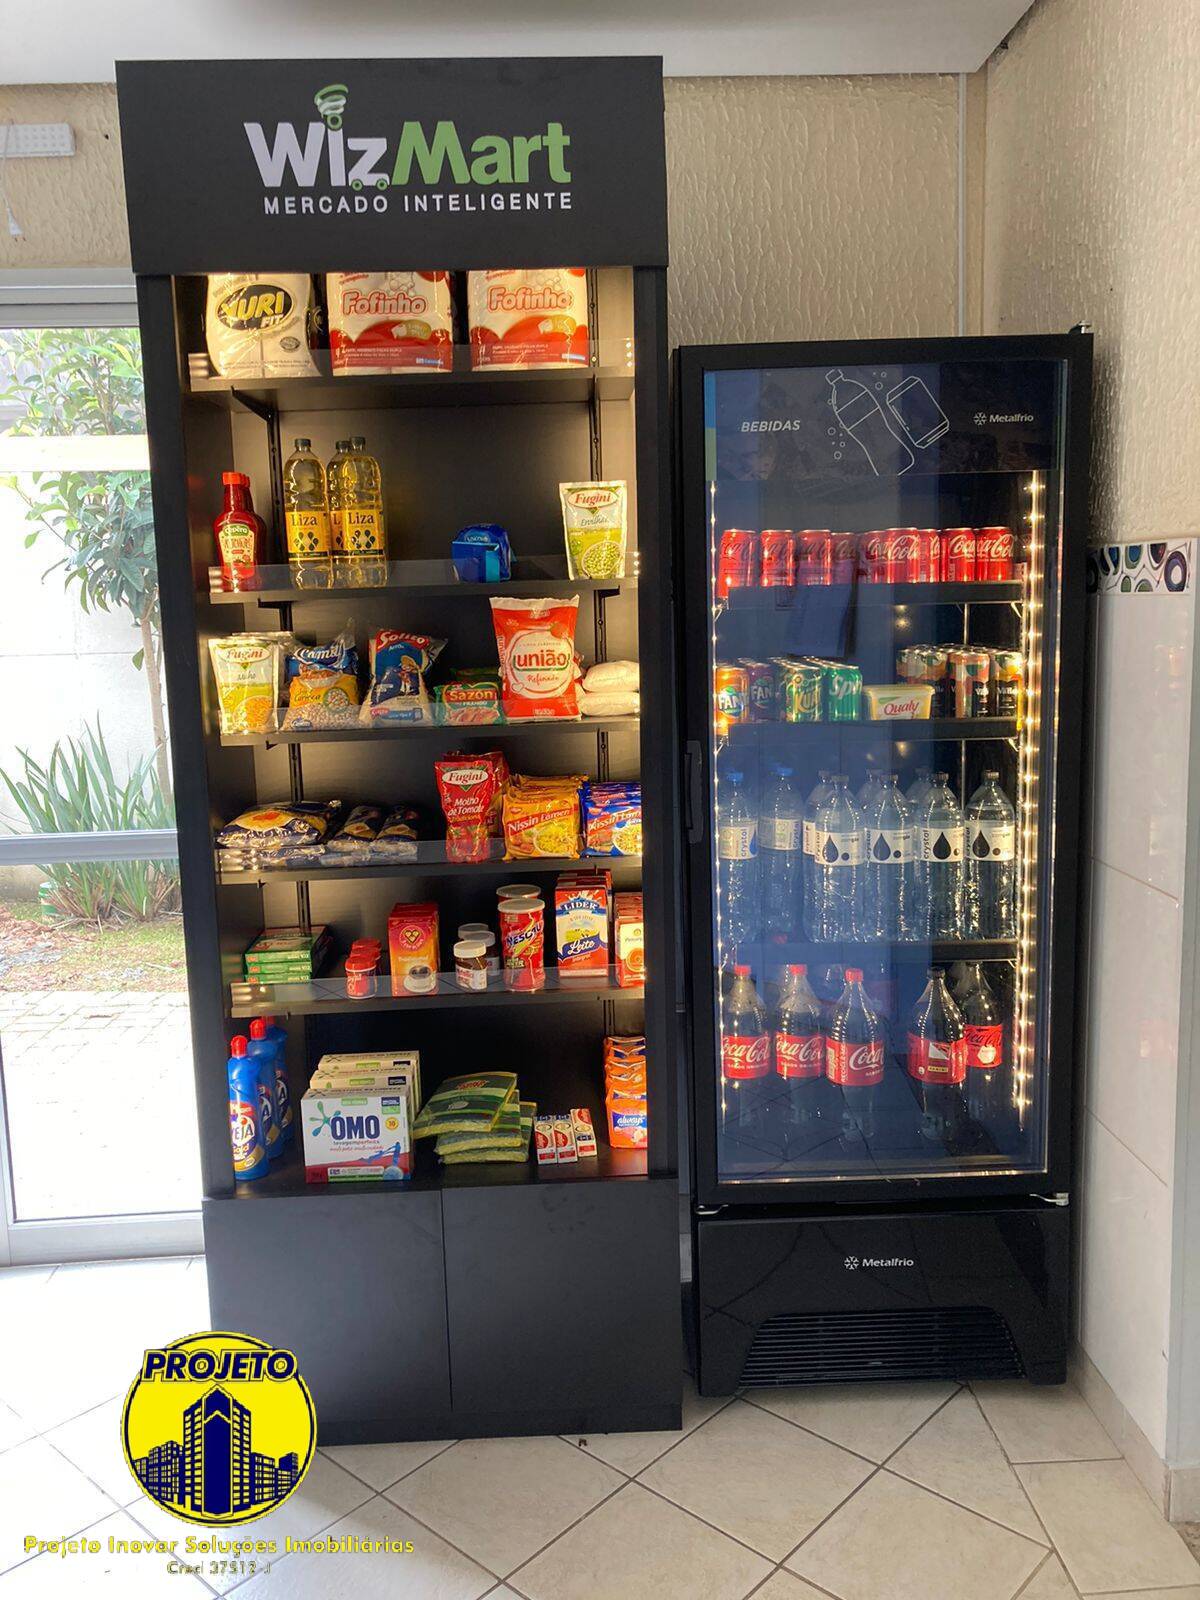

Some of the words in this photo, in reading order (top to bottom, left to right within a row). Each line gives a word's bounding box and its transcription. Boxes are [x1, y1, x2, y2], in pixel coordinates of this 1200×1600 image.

[263, 194, 389, 215] MERCADO
[403, 191, 574, 211] INTELIGENTE
[343, 291, 428, 316] Fofinho
[488, 286, 574, 314] Fofinho
[989, 413, 1035, 423] Metalfrio
[740, 420, 801, 433] BEBIDAS
[574, 492, 612, 506] Fugini
[291, 514, 318, 527] Liza
[348, 512, 376, 525] Liza
[228, 648, 264, 662] Fugini
[517, 650, 567, 668] união
[884, 700, 921, 718] Qualy
[447, 770, 484, 785] Fugini
[508, 815, 540, 832] Nissin
[567, 938, 596, 955] Leite
[331, 1115, 381, 1140] OMO
[862, 1257, 914, 1269] Metalfrio
